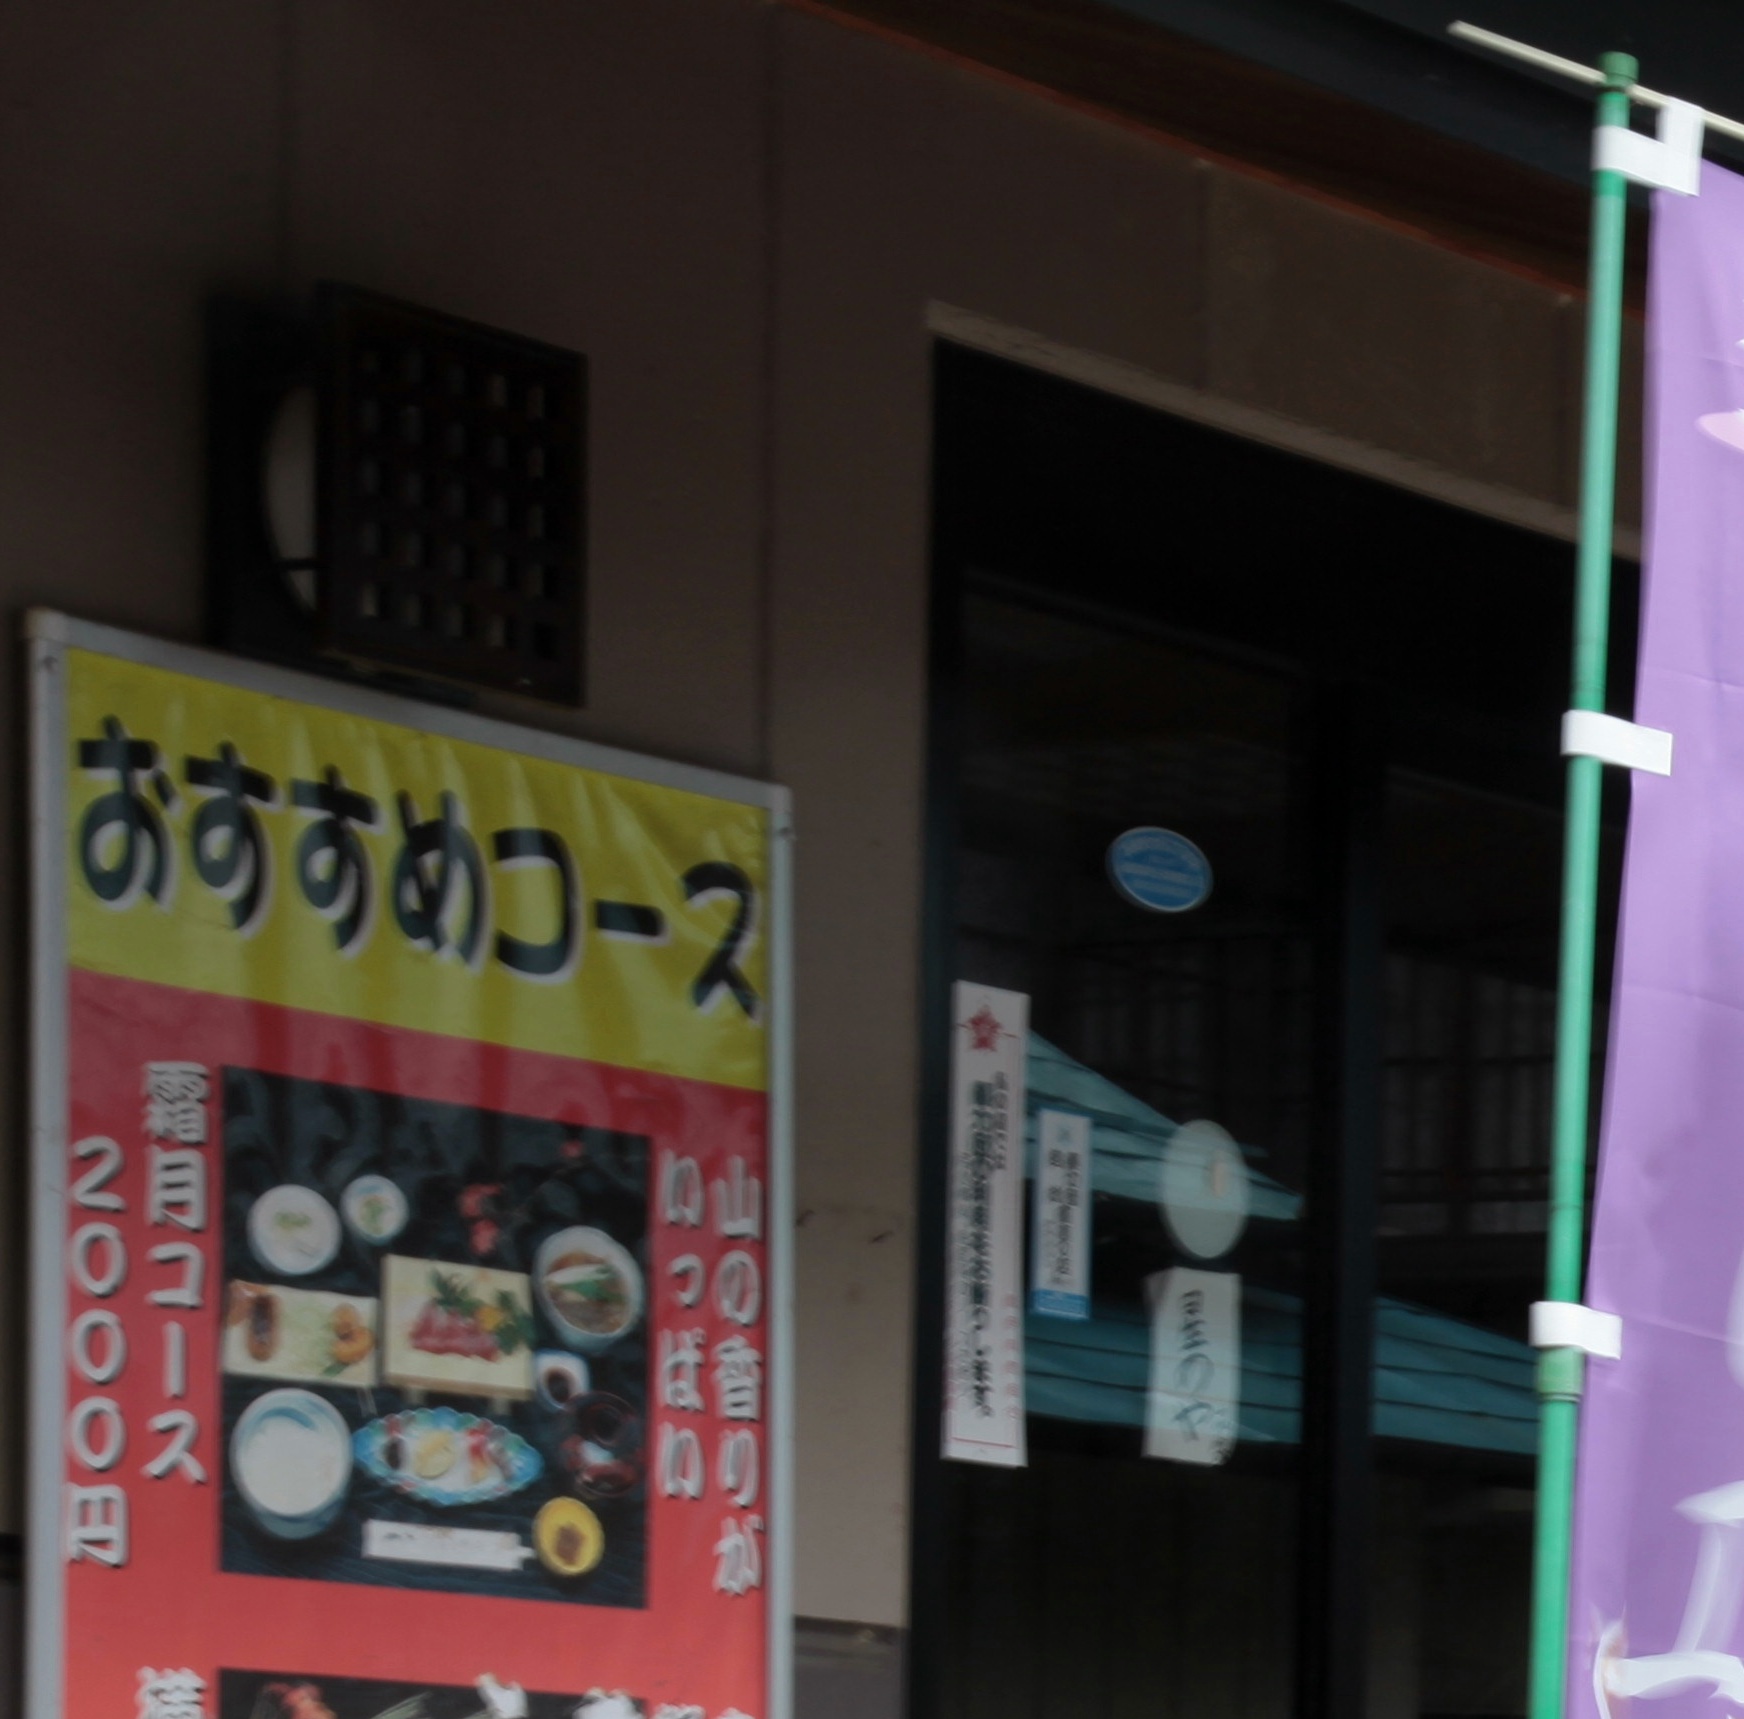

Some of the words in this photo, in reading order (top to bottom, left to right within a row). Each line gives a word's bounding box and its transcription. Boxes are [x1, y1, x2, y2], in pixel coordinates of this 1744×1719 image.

[78, 715, 760, 1020] おすすめコース
[67, 1135, 129, 1568] 2000円
[142, 1060, 208, 1483] 霜月コース
